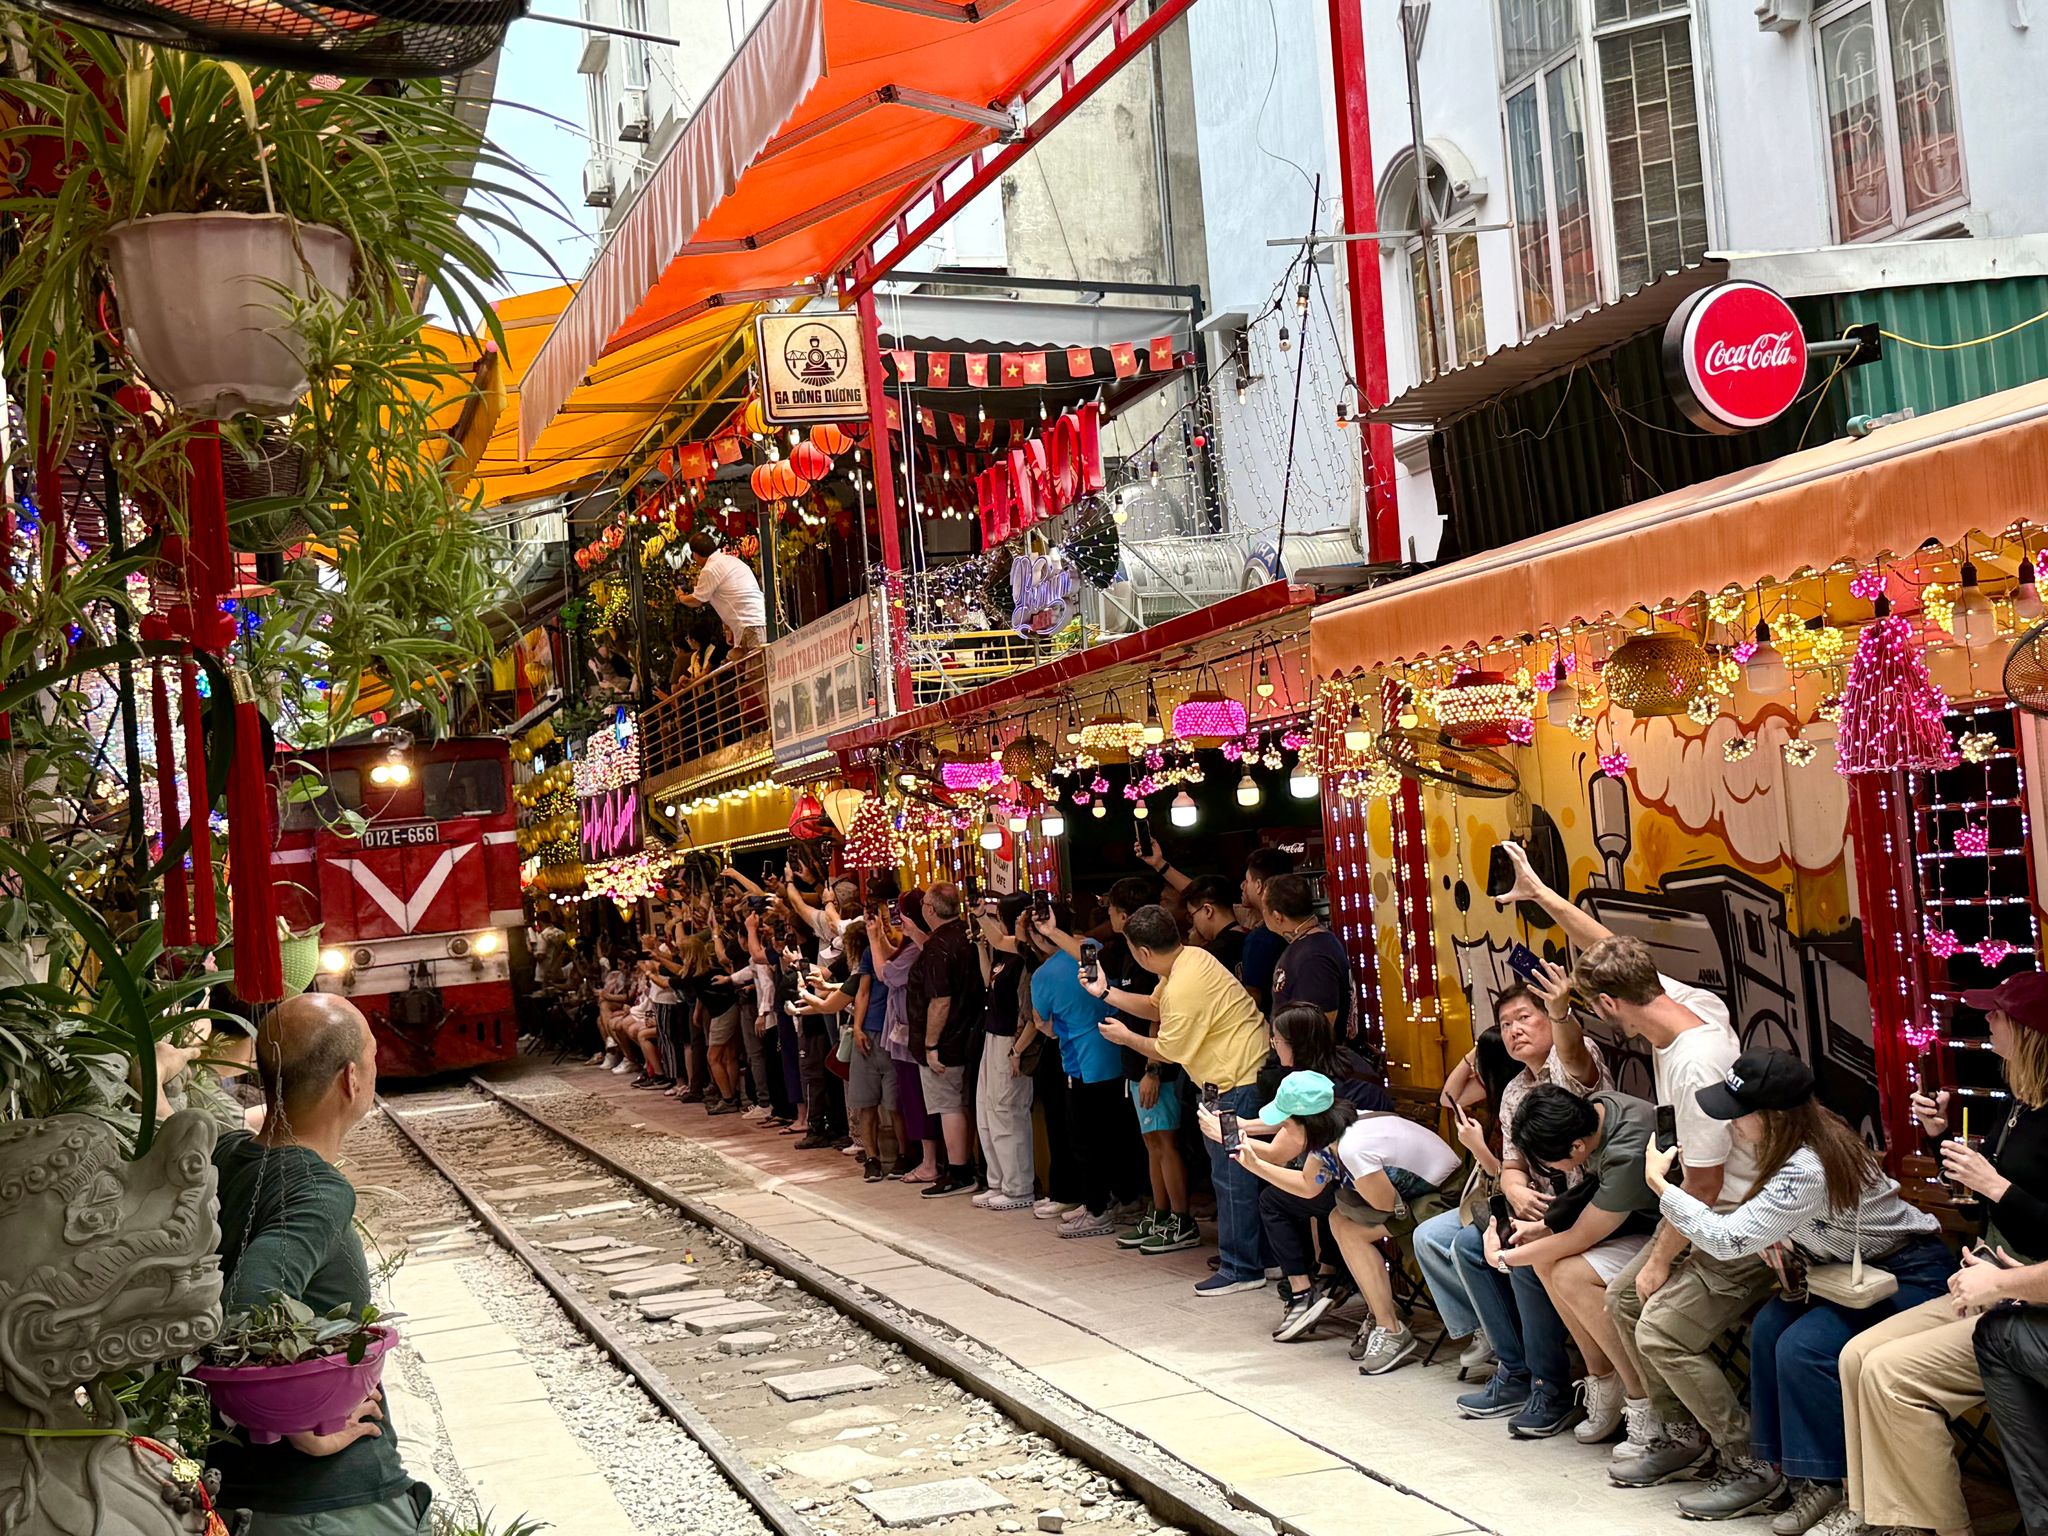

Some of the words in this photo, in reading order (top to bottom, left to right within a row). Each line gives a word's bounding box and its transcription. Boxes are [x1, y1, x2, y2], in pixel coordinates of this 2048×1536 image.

[774, 391, 790, 405] GA
[792, 387, 822, 404] ĐÔNG
[825, 387, 862, 403] DƯƠNG
[974, 401, 1106, 555] HANOI
[777, 651, 798, 681] HANOI
[797, 642, 820, 670] TRAIN
[819, 627, 850, 664] STREET
[1697, 968, 1724, 987] ANNA
[1704, 1331, 1794, 1376] Coca-Cola
